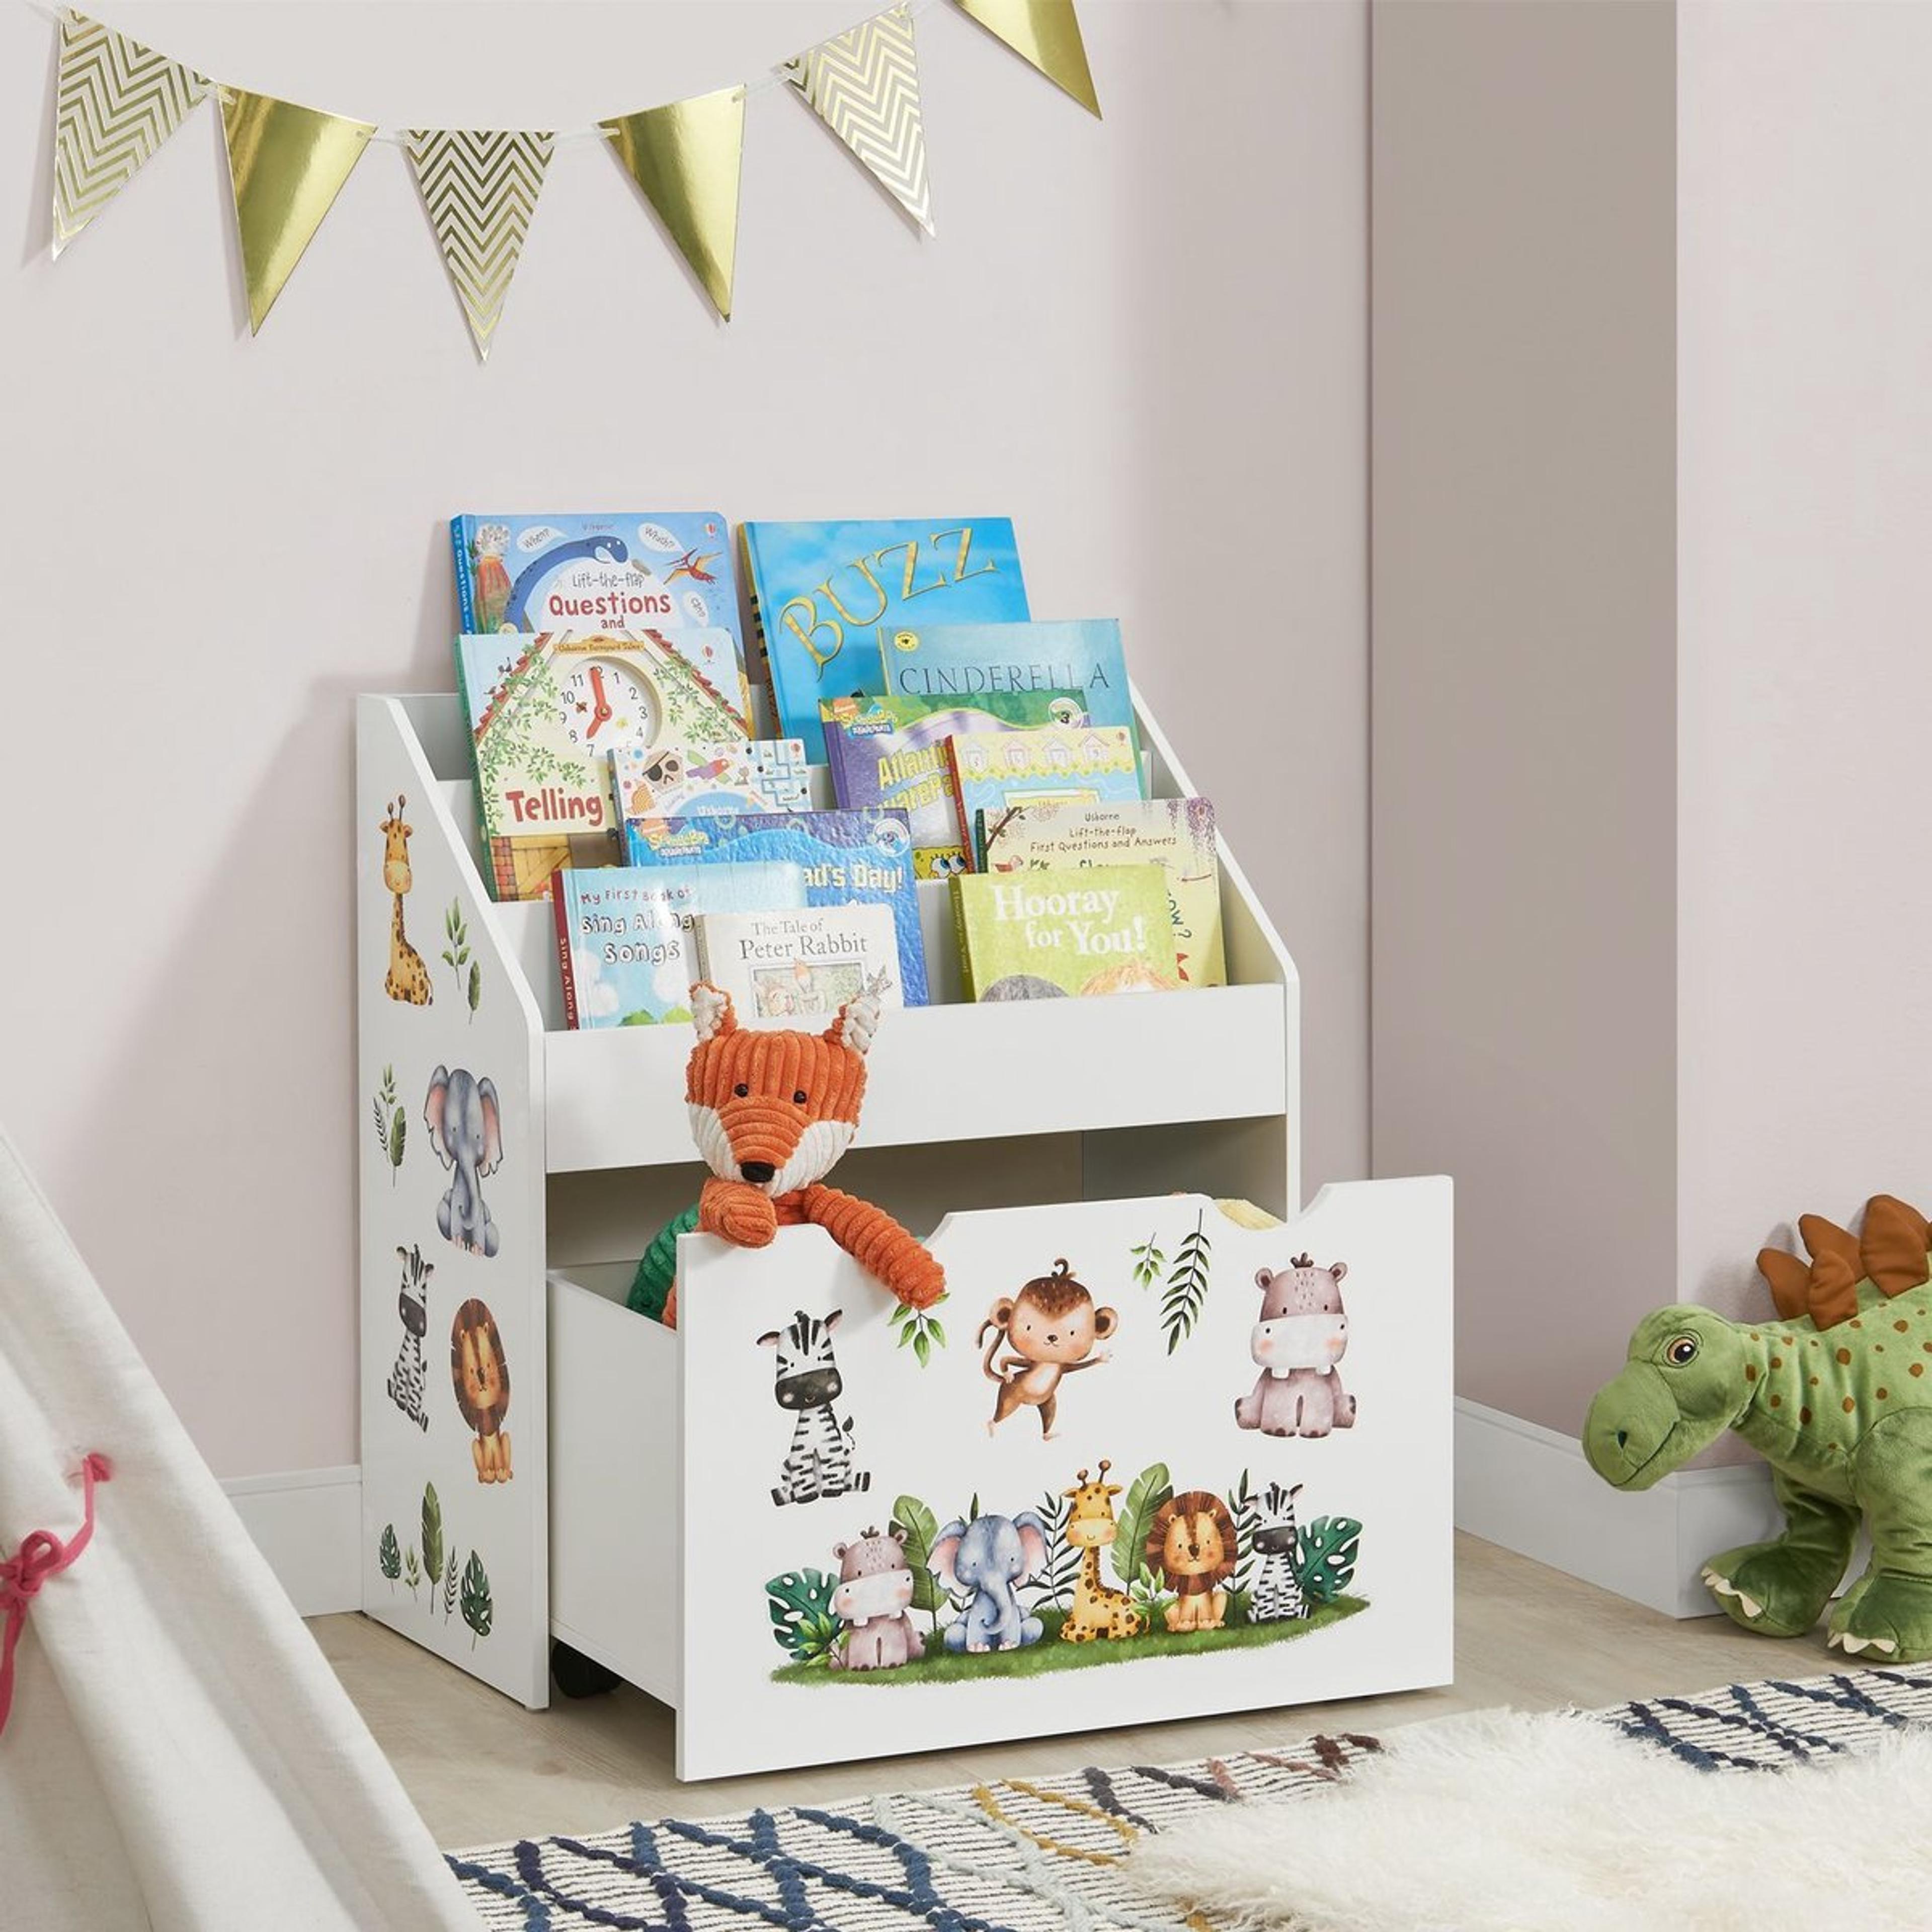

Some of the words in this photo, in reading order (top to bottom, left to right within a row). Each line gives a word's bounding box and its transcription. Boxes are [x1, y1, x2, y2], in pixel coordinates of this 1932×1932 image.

[573, 572, 646, 588] Lift-the-flap
[549, 592, 671, 615] Questions
[779, 527, 1002, 682] BUZZ
[600, 615, 625, 629] and
[570, 674, 584, 686] 11
[614, 672, 620, 684] 1
[899, 662, 1110, 695] CINDERELLA
[560, 691, 575, 704] 10
[629, 687, 638, 700] 2
[558, 711, 567, 723] 9
[638, 705, 648, 719] 3
[569, 730, 578, 743] 8
[636, 727, 643, 738] 4
[587, 744, 595, 757] 7
[505, 787, 603, 826] Telling
[1084, 812, 1120, 822] Usborne
[1069, 825, 1137, 839] Lift-the-flap
[1030, 841, 1055, 853] First
[1058, 840, 1108, 853] Questions
[1111, 837, 1131, 848] and
[1134, 836, 1177, 847] Answers
[803, 863, 846, 888] ad's
[850, 863, 903, 894] Day!
[580, 893, 601, 904] My
[605, 888, 638, 901] First
[989, 884, 1120, 924] Hooray
[581, 913, 627, 935] Sing
[751, 922, 778, 936] The
[779, 919, 807, 934] Tale
[809, 917, 825, 933] of
[1025, 920, 1063, 948] for
[1065, 915, 1147, 955] You!
[604, 939, 681, 966] Songs
[740, 938, 793, 960] Peter
[799, 930, 868, 956] Rabbit
[559, 937, 569, 970] Sing
[564, 975, 575, 1020] Along
